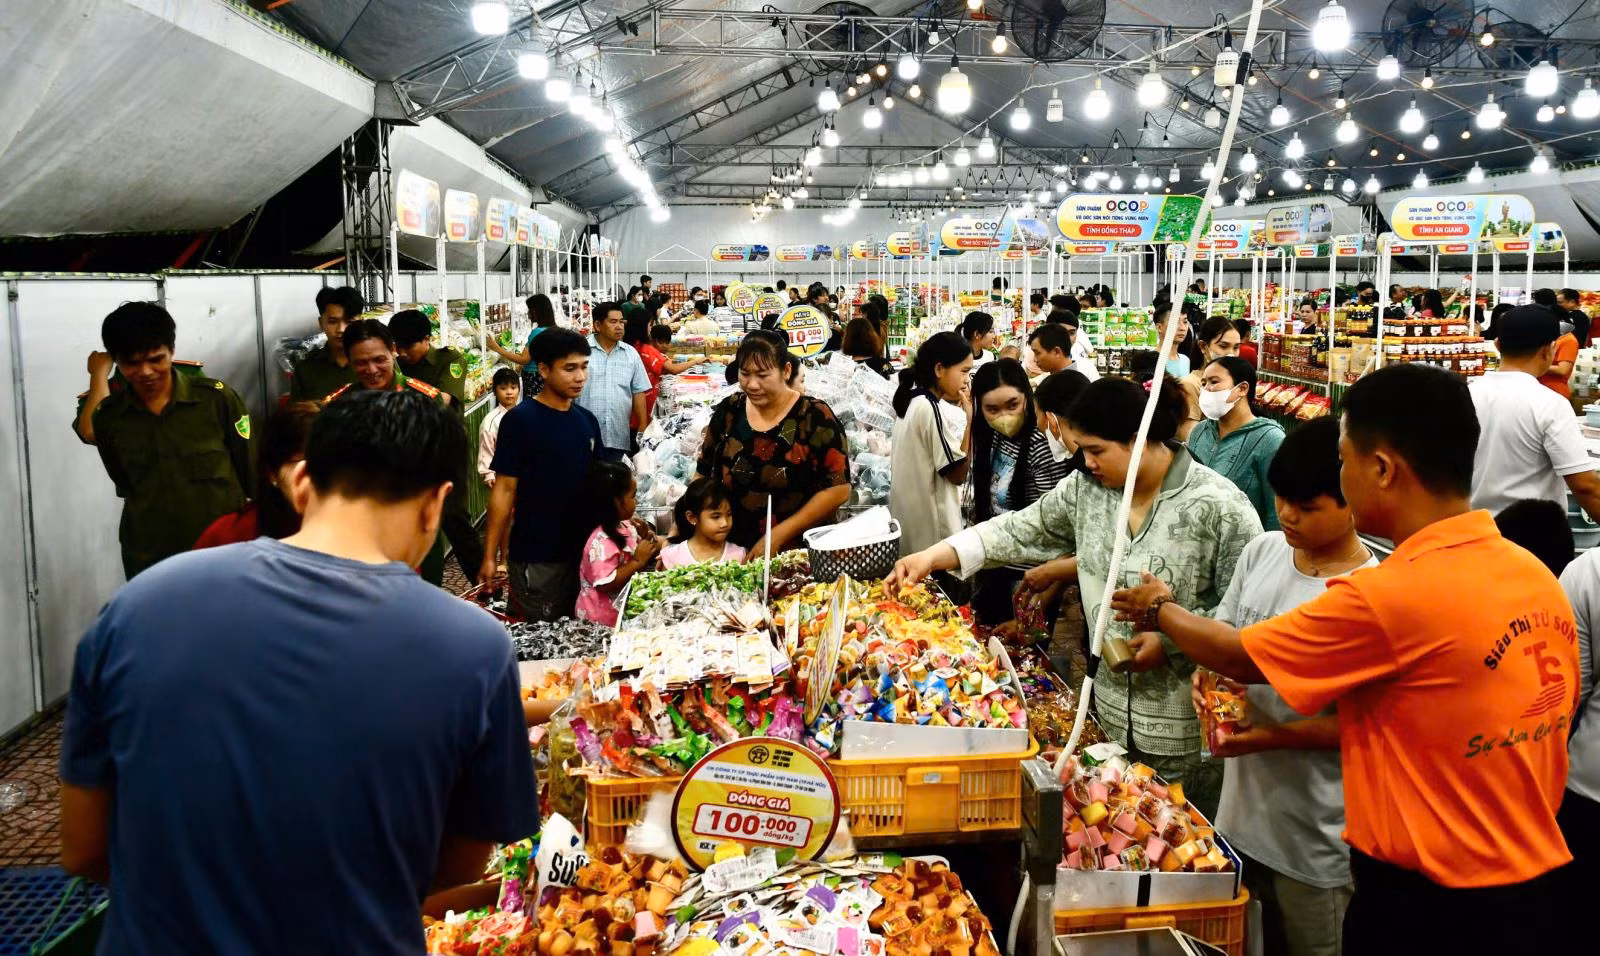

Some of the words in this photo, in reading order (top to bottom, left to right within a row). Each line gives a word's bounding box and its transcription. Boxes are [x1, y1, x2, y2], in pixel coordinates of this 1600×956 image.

[1106, 200, 1149, 212] OCOP
[1436, 201, 1474, 211] OCOP
[1484, 633, 1512, 670] Siêu
[1509, 615, 1532, 638] Thị
[728, 790, 765, 807] ĐỒNG
[767, 796, 790, 811] GIÁ
[763, 831, 794, 842] đồng/kg
